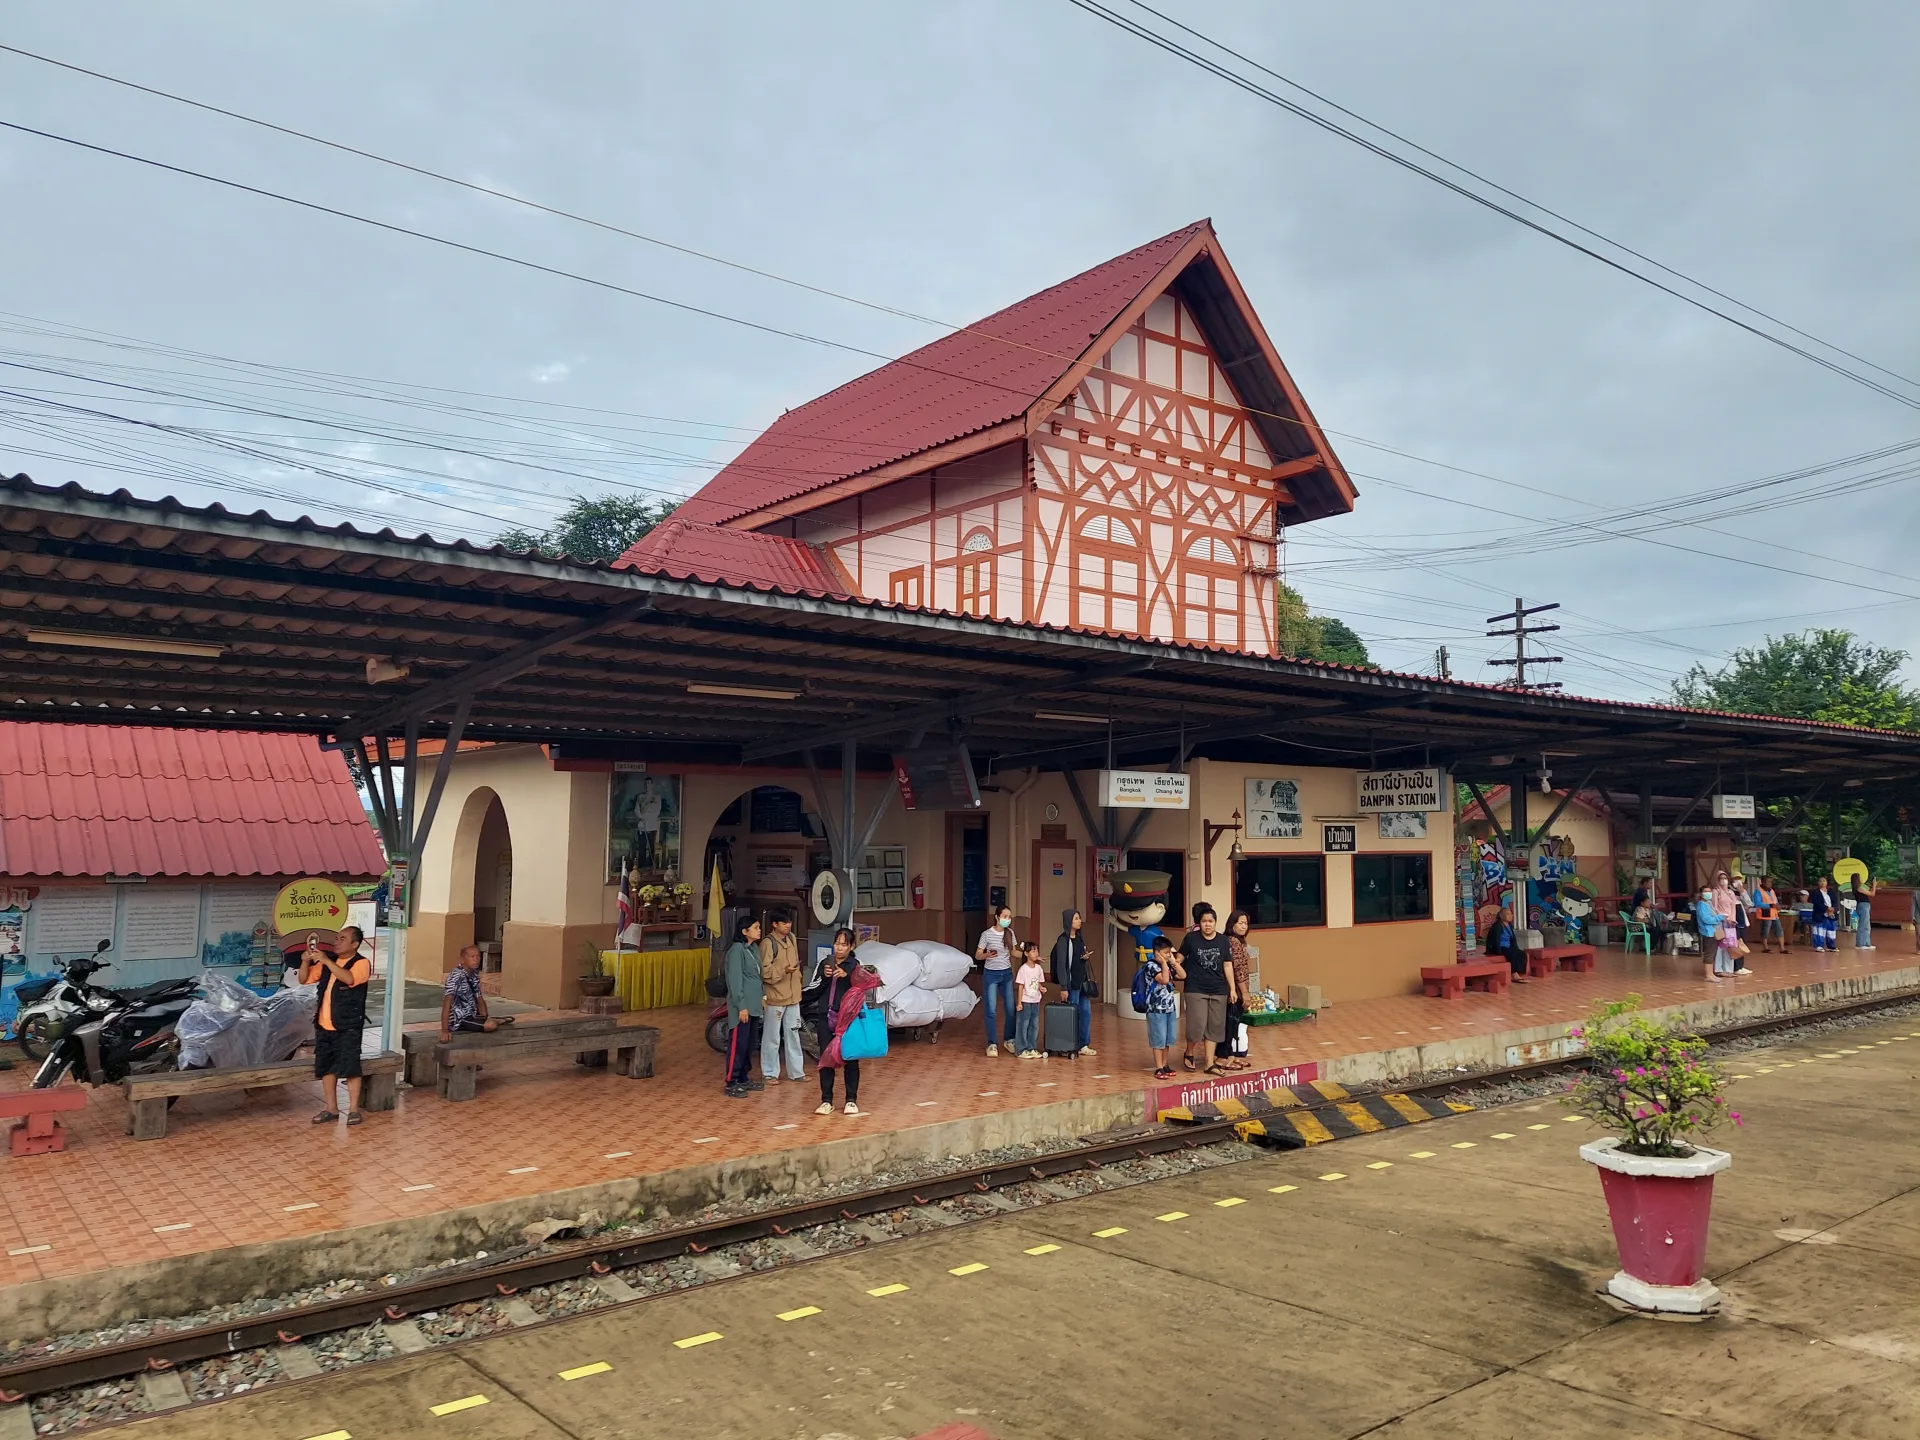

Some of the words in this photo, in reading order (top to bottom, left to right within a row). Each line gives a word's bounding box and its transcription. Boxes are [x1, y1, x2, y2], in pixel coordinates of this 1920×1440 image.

[1116, 777, 1145, 787] กรุงเทพ
[1362, 770, 1433, 791] สถานีบ้านปิน
[1360, 794, 1394, 807] BANPIN
[1398, 792, 1436, 806] STATION
[289, 887, 336, 906] ซื้อตั๋วรถ
